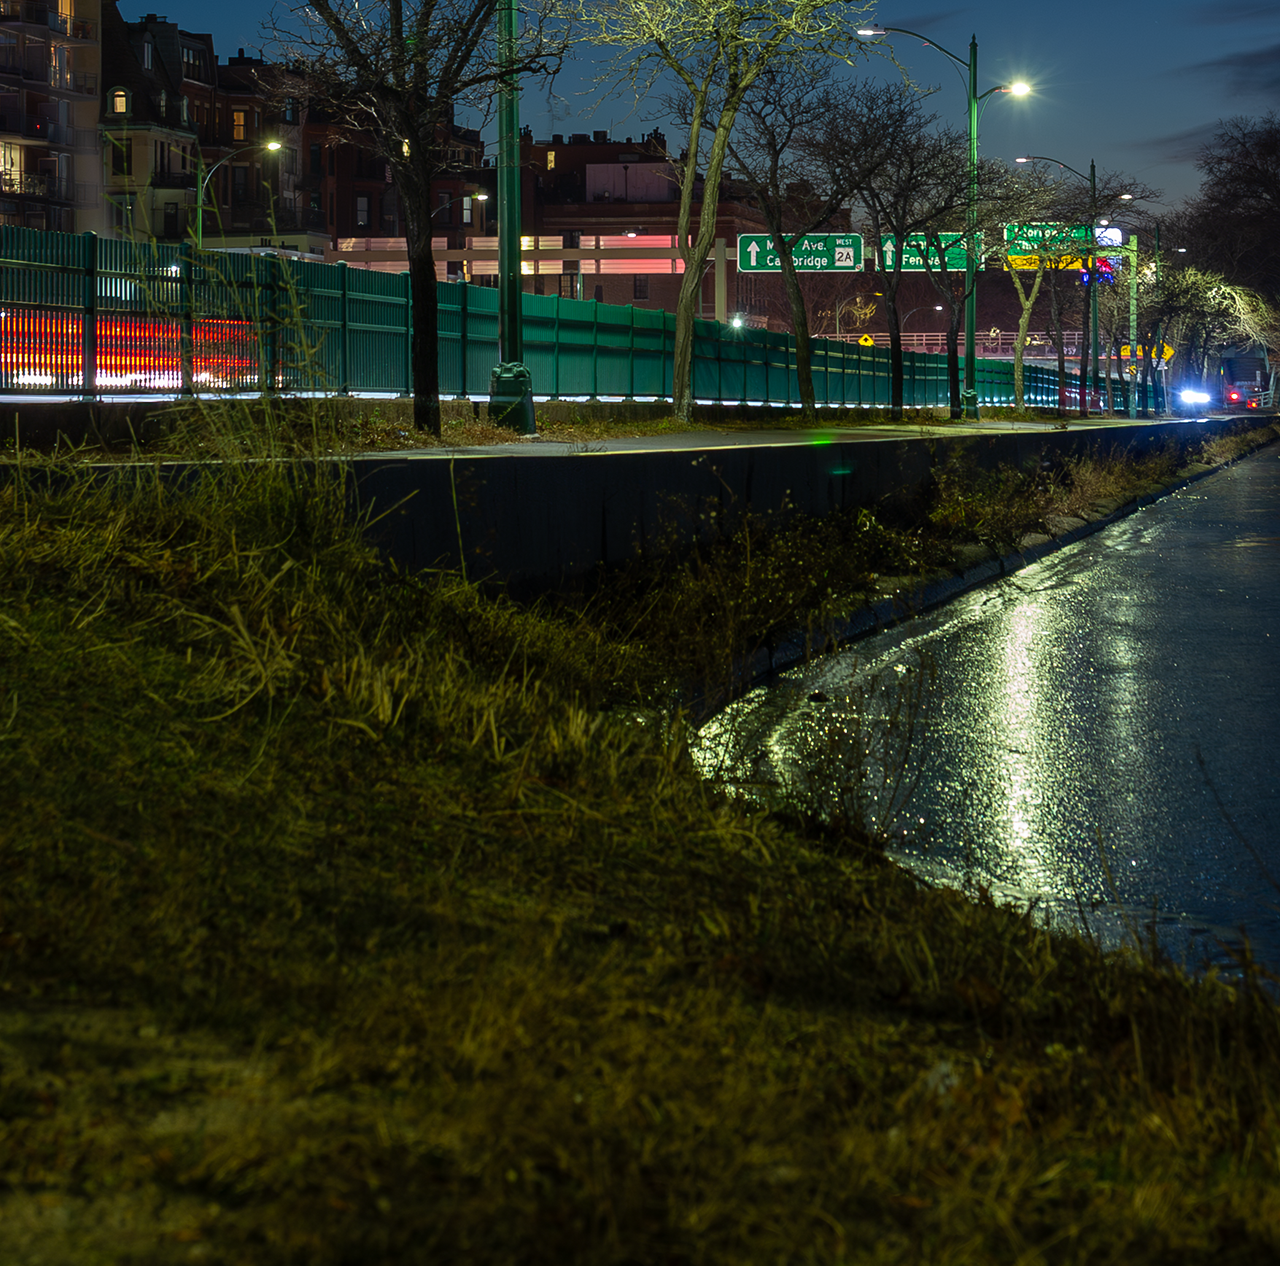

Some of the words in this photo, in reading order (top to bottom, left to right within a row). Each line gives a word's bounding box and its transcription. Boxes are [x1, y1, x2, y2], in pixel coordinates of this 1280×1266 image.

[802, 239, 826, 250] Ave.
[766, 255, 828, 269] Cabridge
[837, 252, 852, 262] 2A
